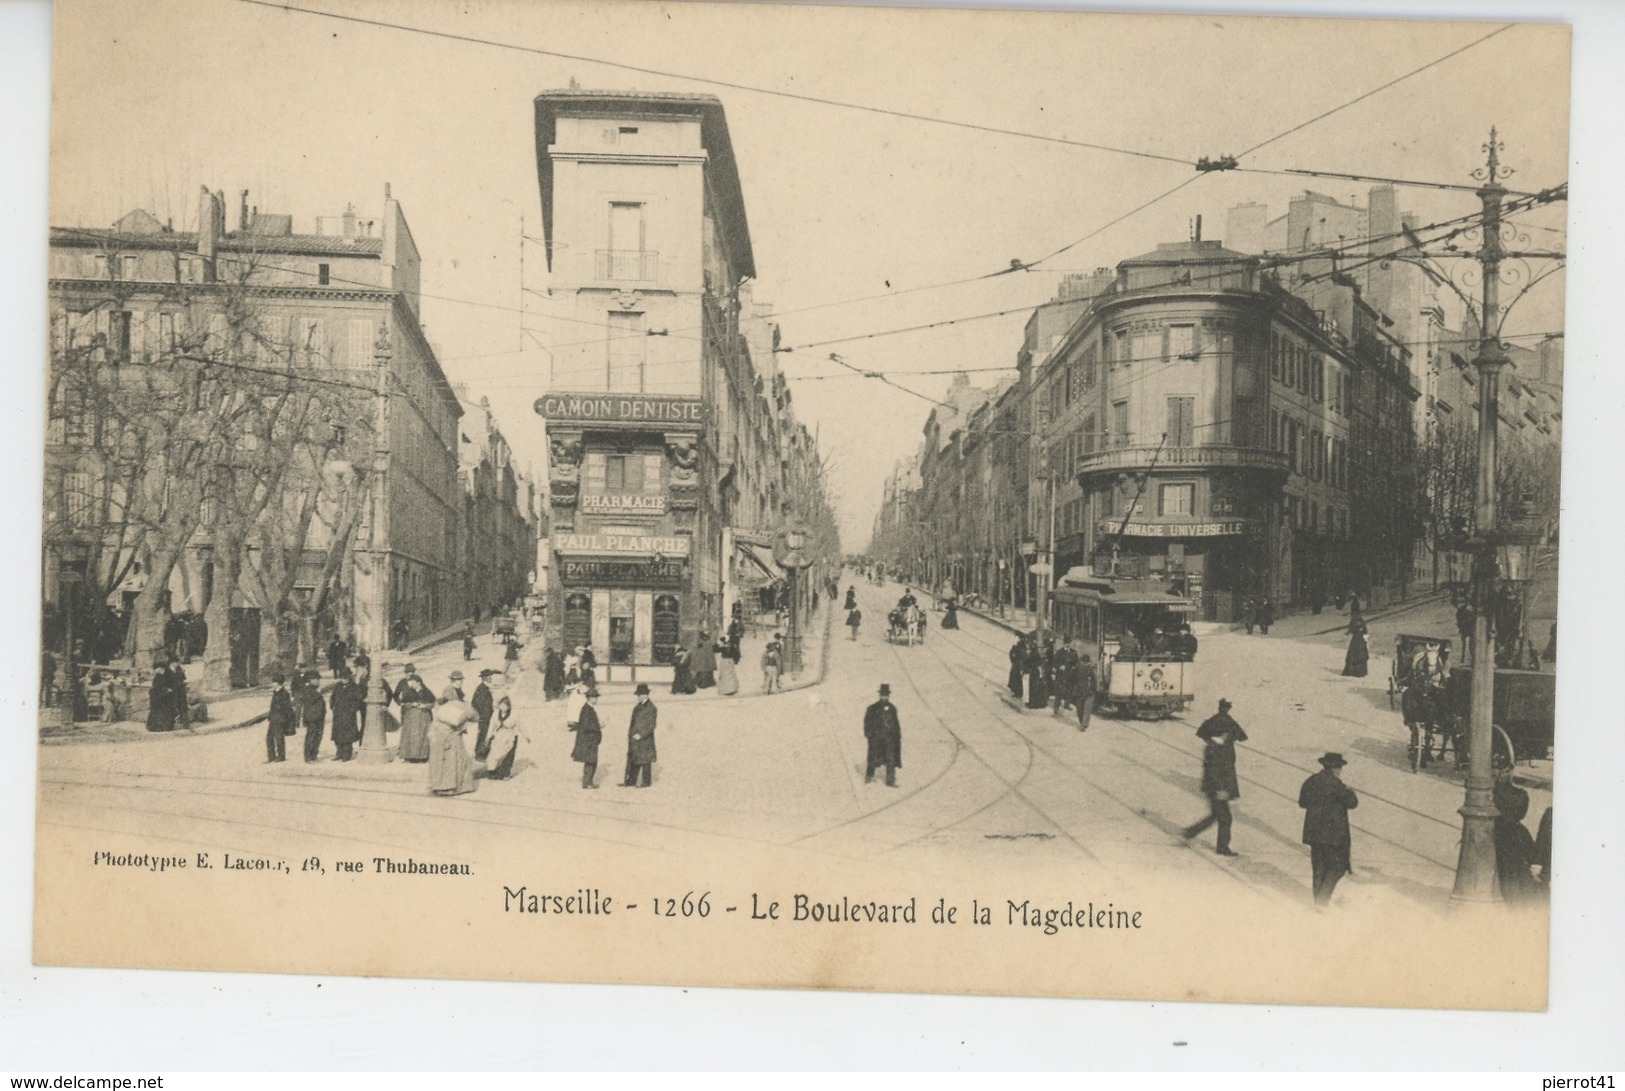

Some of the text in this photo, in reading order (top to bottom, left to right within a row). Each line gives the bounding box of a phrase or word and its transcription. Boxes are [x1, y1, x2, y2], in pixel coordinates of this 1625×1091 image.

[545, 399, 702, 419] CAMOIN DENTISTE
[582, 495, 665, 508] PHARMACIE
[1169, 523, 1242, 536] UNIVERSELLE
[557, 534, 689, 550] PAUL PLANCHE
[566, 563, 604, 575] PAUL
